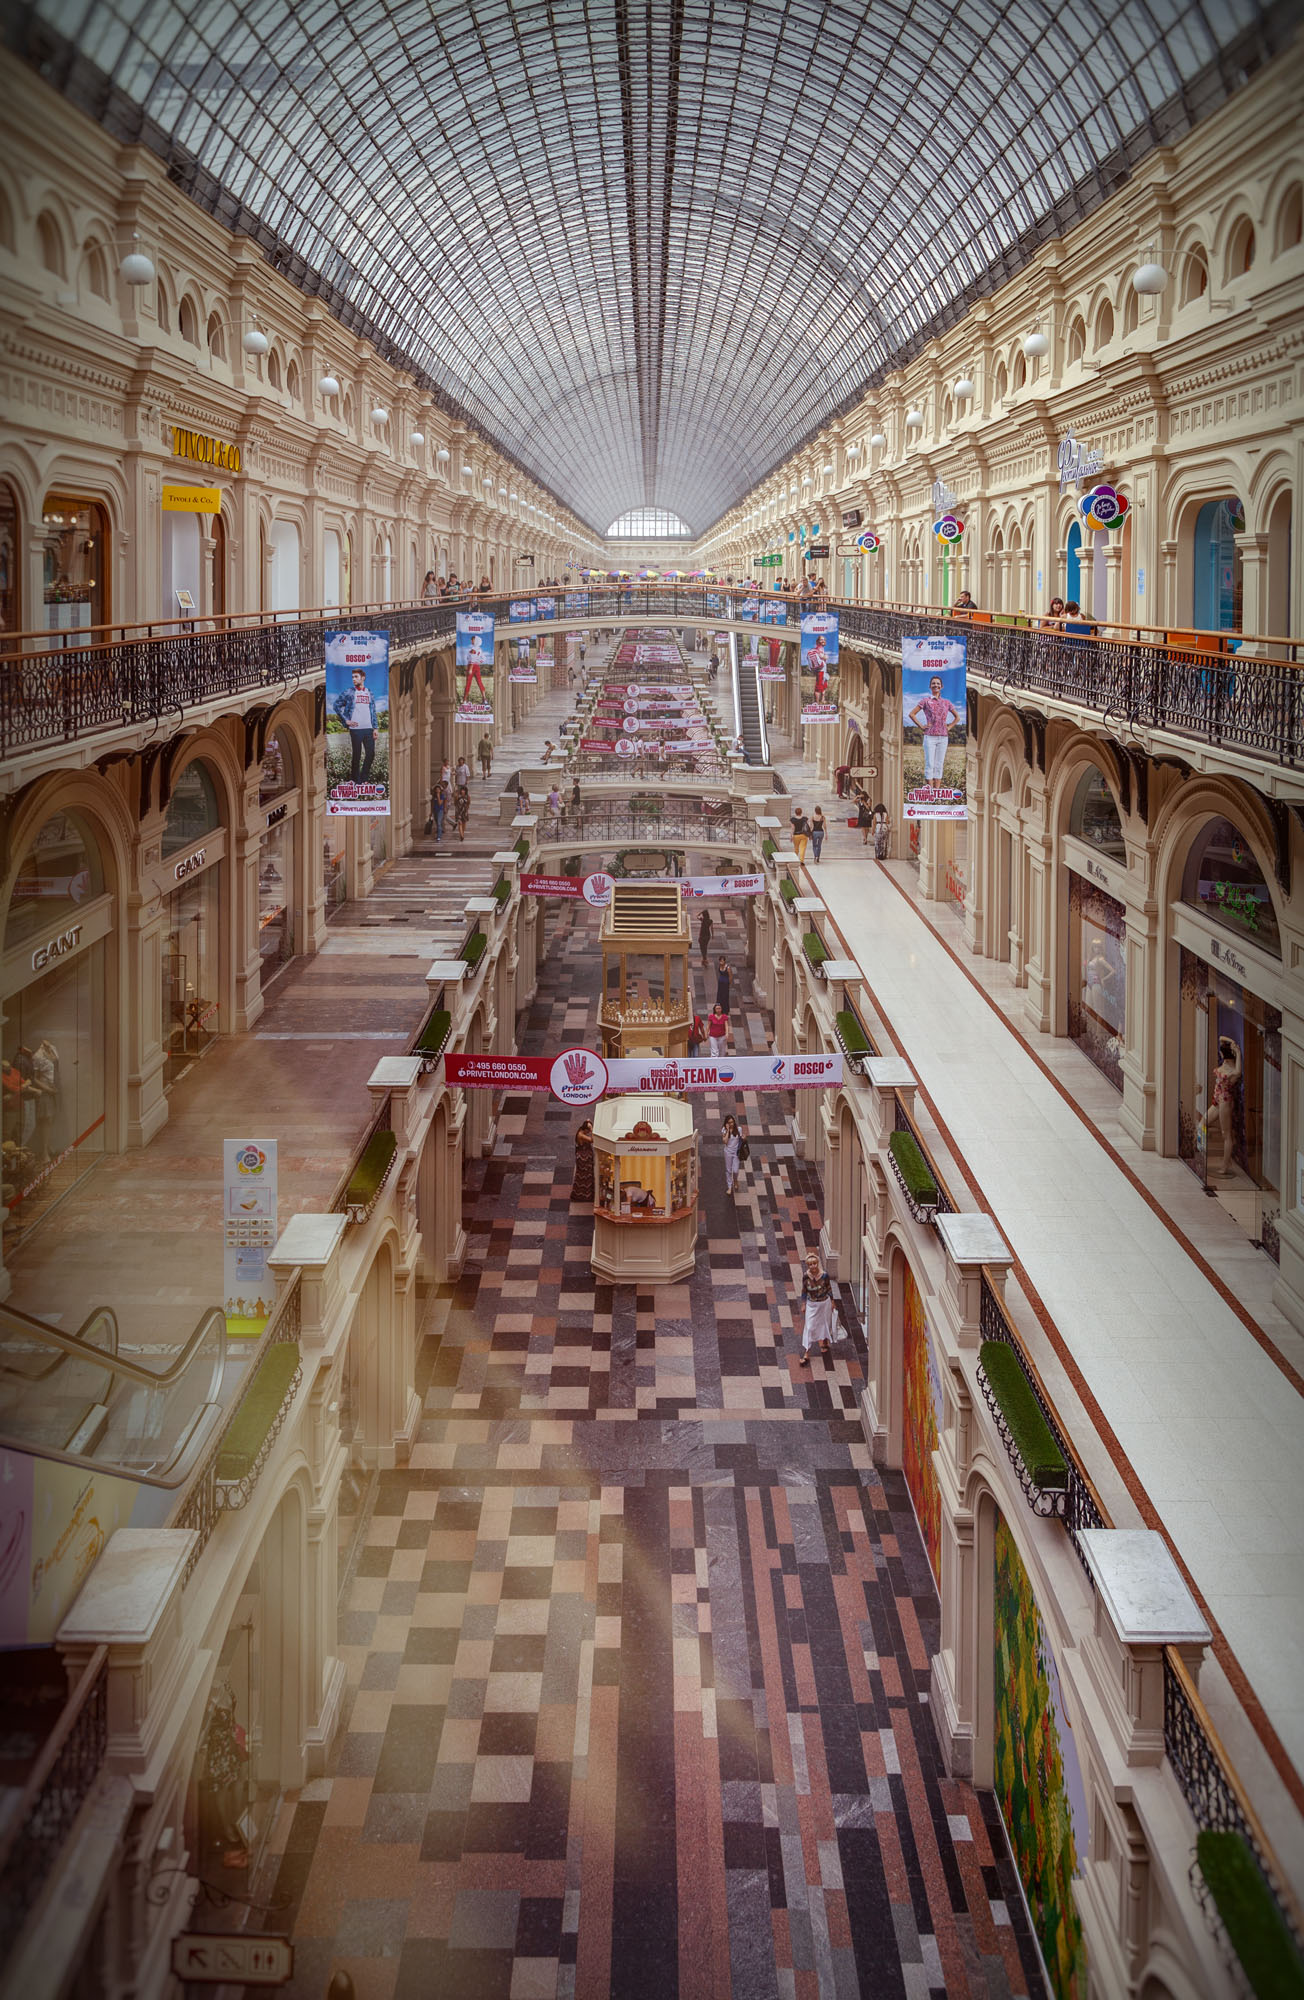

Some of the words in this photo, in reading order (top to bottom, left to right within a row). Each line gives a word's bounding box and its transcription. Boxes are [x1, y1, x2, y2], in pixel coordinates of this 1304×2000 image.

[173, 426, 215, 464] TIVOLI
[345, 654, 366, 663] BOSCO
[922, 659, 943, 668] BOSCO
[331, 790, 358, 798] OLYMPIC
[357, 785, 376, 794] TEAM
[908, 793, 935, 802] OLYMPIC
[933, 789, 953, 798] TEAM
[174, 848, 207, 881] GANT
[533, 884, 578, 892] PRIVETLONDON.COM
[734, 879, 754, 888] BOSCO
[32, 925, 83, 970] GANT
[476, 1062, 491, 1070] 495
[491, 1063, 507, 1071] 660
[793, 1061, 825, 1075] BOSCO
[466, 1069, 538, 1080] PRIVETLONDON.COM
[640, 1077, 685, 1091] OLYMPIC
[683, 1068, 717, 1083] TEAM
[650, 1069, 678, 1078] RUSSIAN
